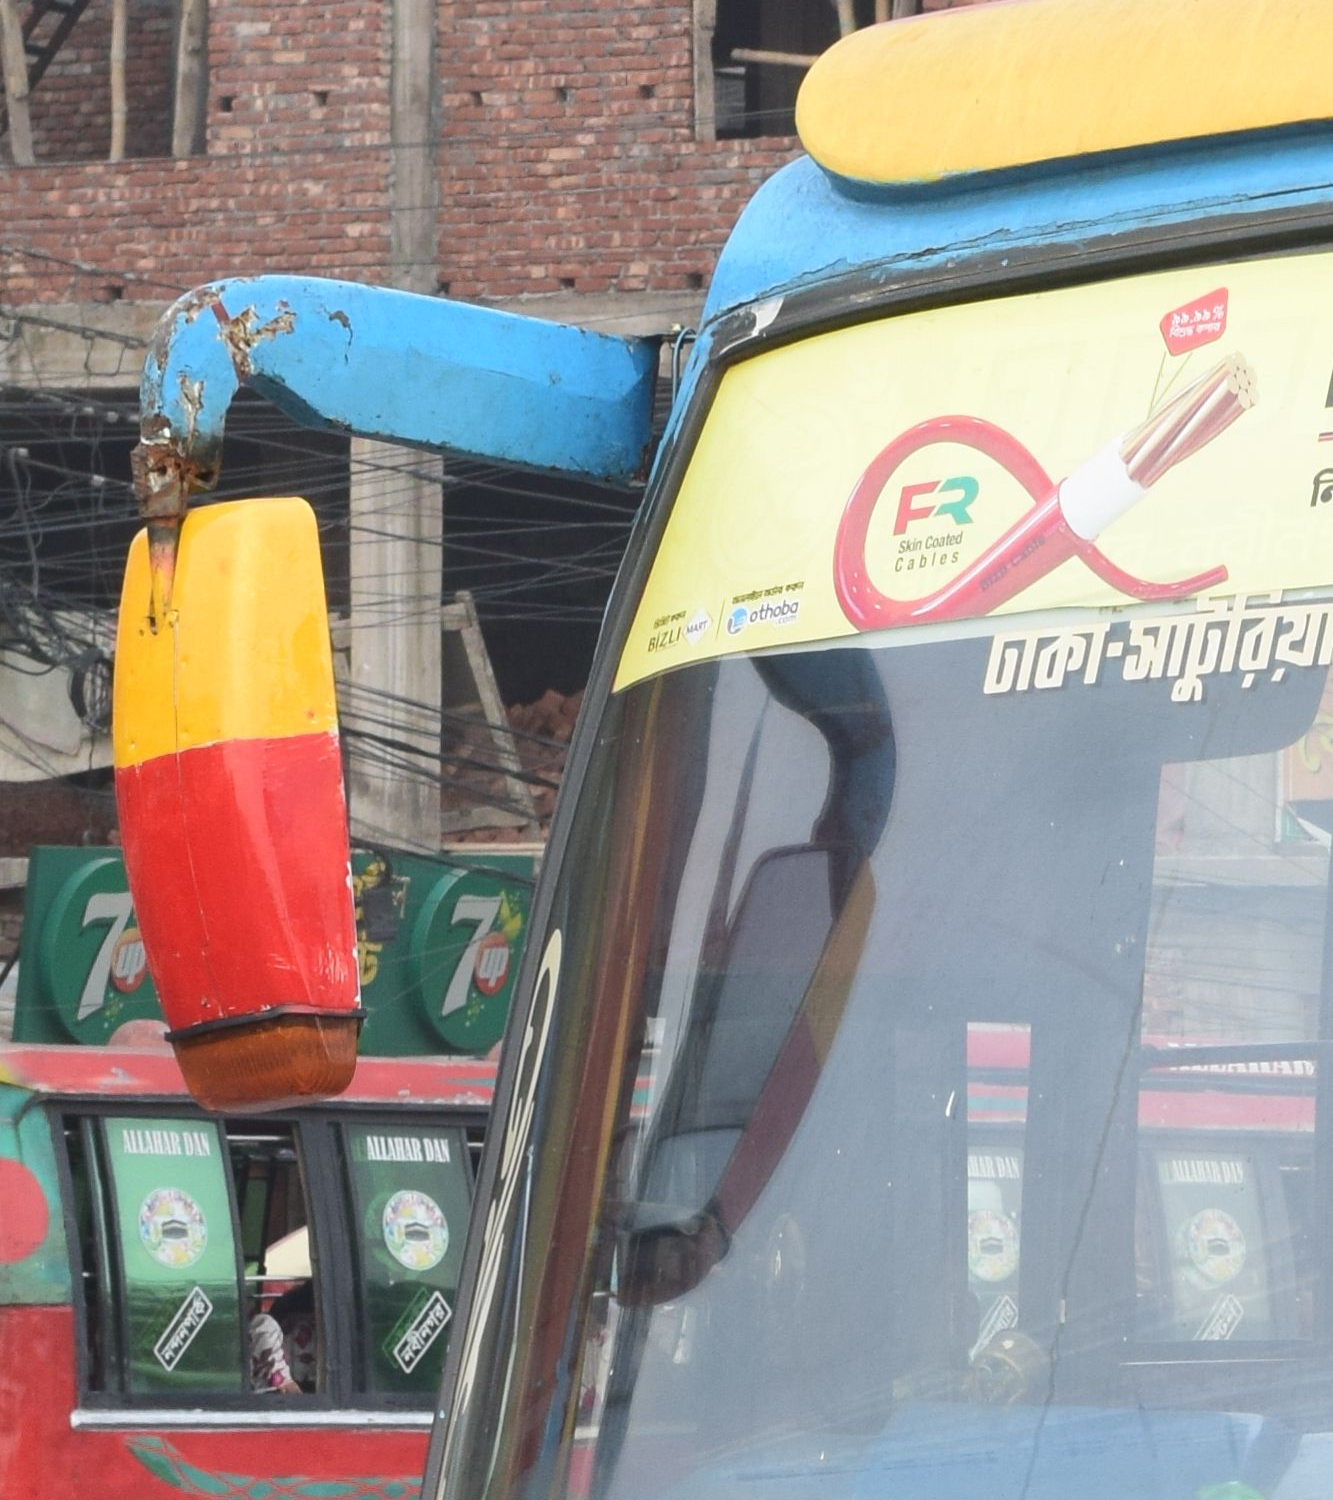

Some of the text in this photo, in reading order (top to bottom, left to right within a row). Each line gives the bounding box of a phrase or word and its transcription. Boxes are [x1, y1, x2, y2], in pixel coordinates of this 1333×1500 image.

[898, 531, 963, 554] Skin Coated
[894, 551, 960, 573] Cables
[749, 600, 799, 623] othoba
[122, 1129, 212, 1156] ALLAHAR DAN
[366, 1135, 451, 1162] ALLAHAR DAN
